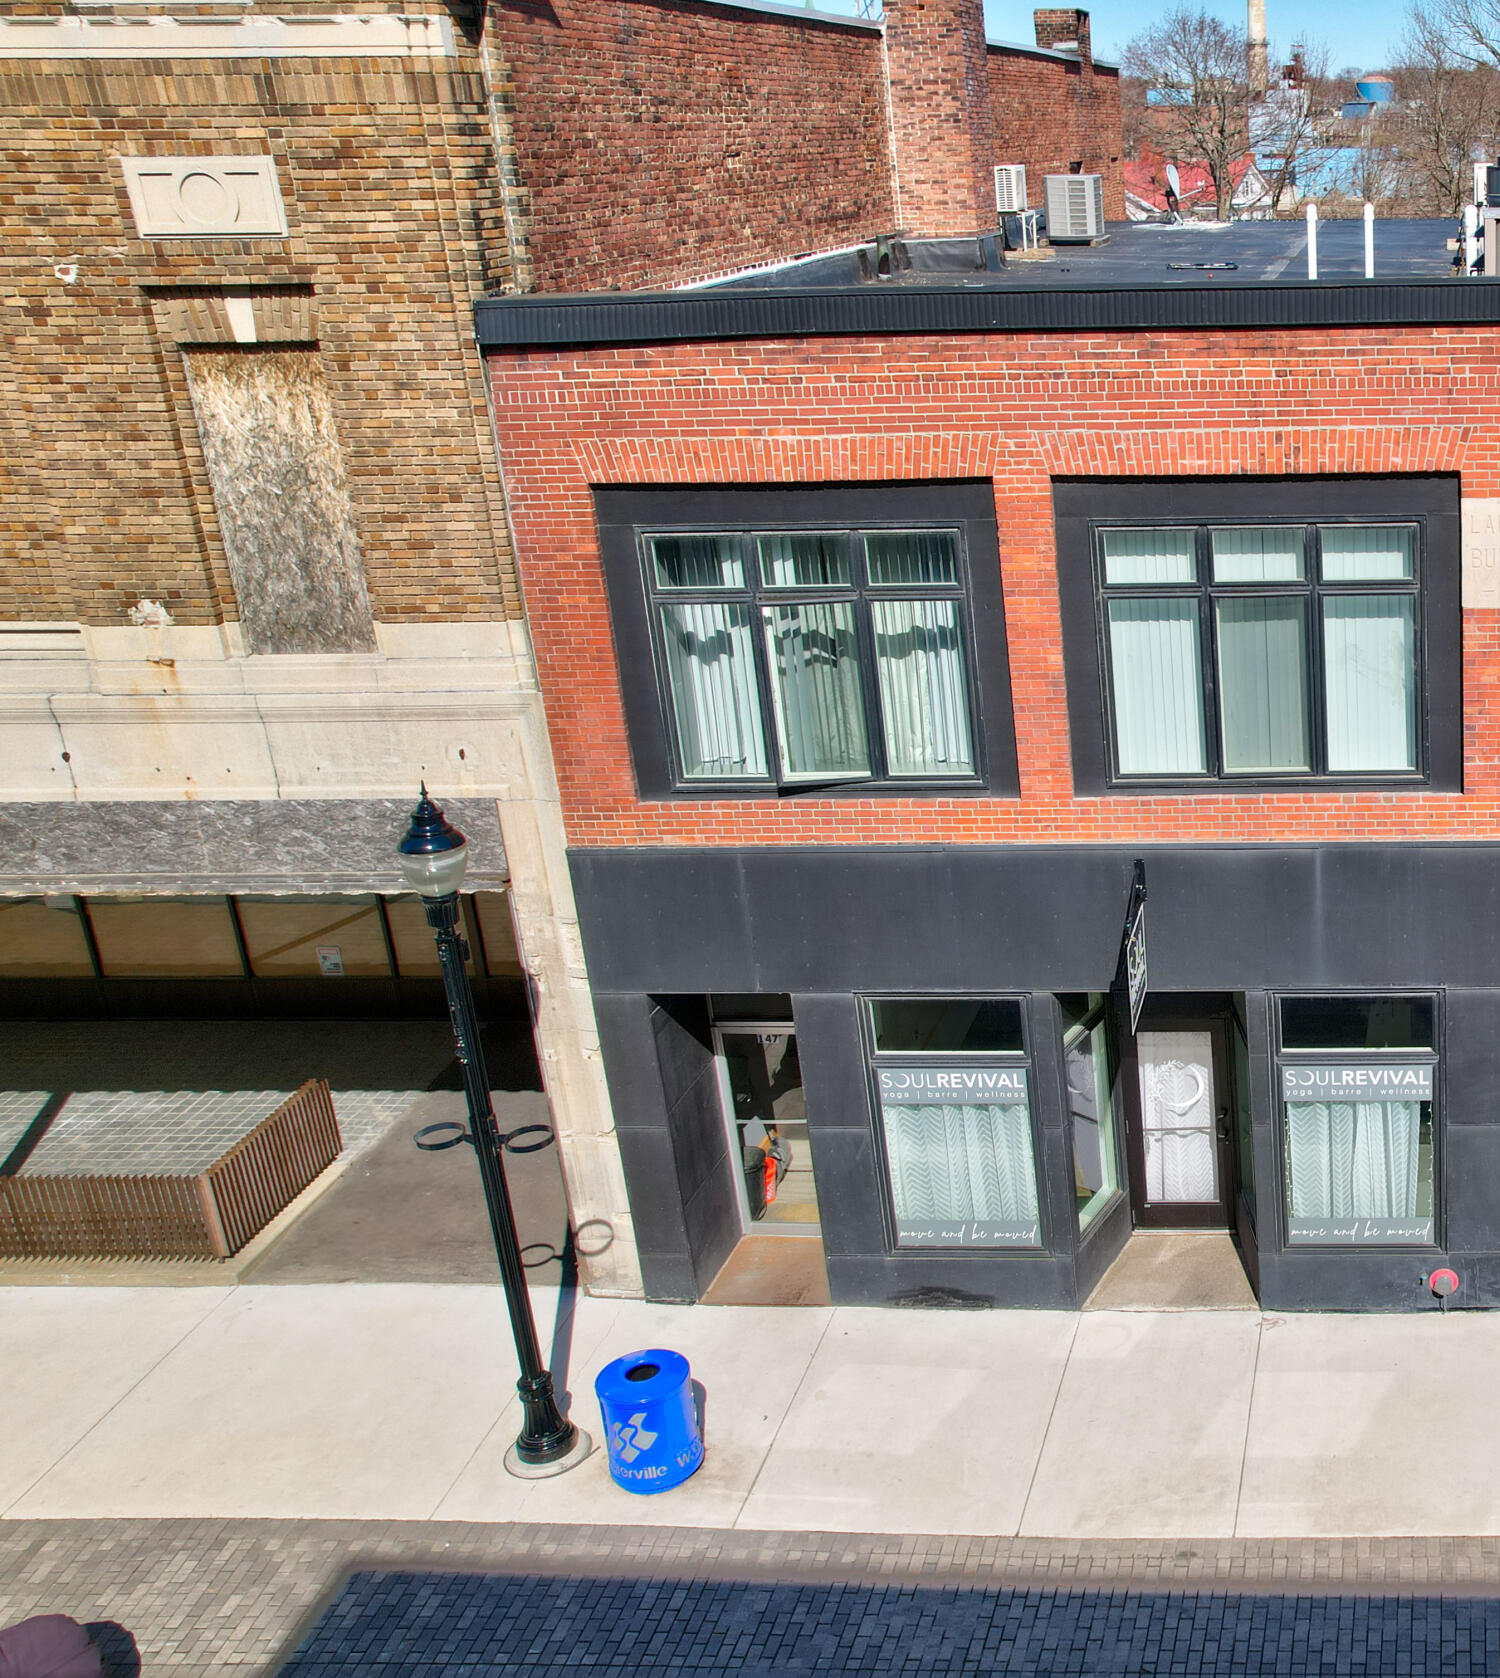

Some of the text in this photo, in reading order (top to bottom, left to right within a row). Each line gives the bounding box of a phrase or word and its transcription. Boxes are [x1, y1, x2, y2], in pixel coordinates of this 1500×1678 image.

[882, 1090, 1026, 1099] yoga barre wellness
[1285, 1088, 1431, 1097] yoga barre wellness
[899, 1223, 1037, 1244] move and be moved
[1290, 1220, 1431, 1241] move and be moved
